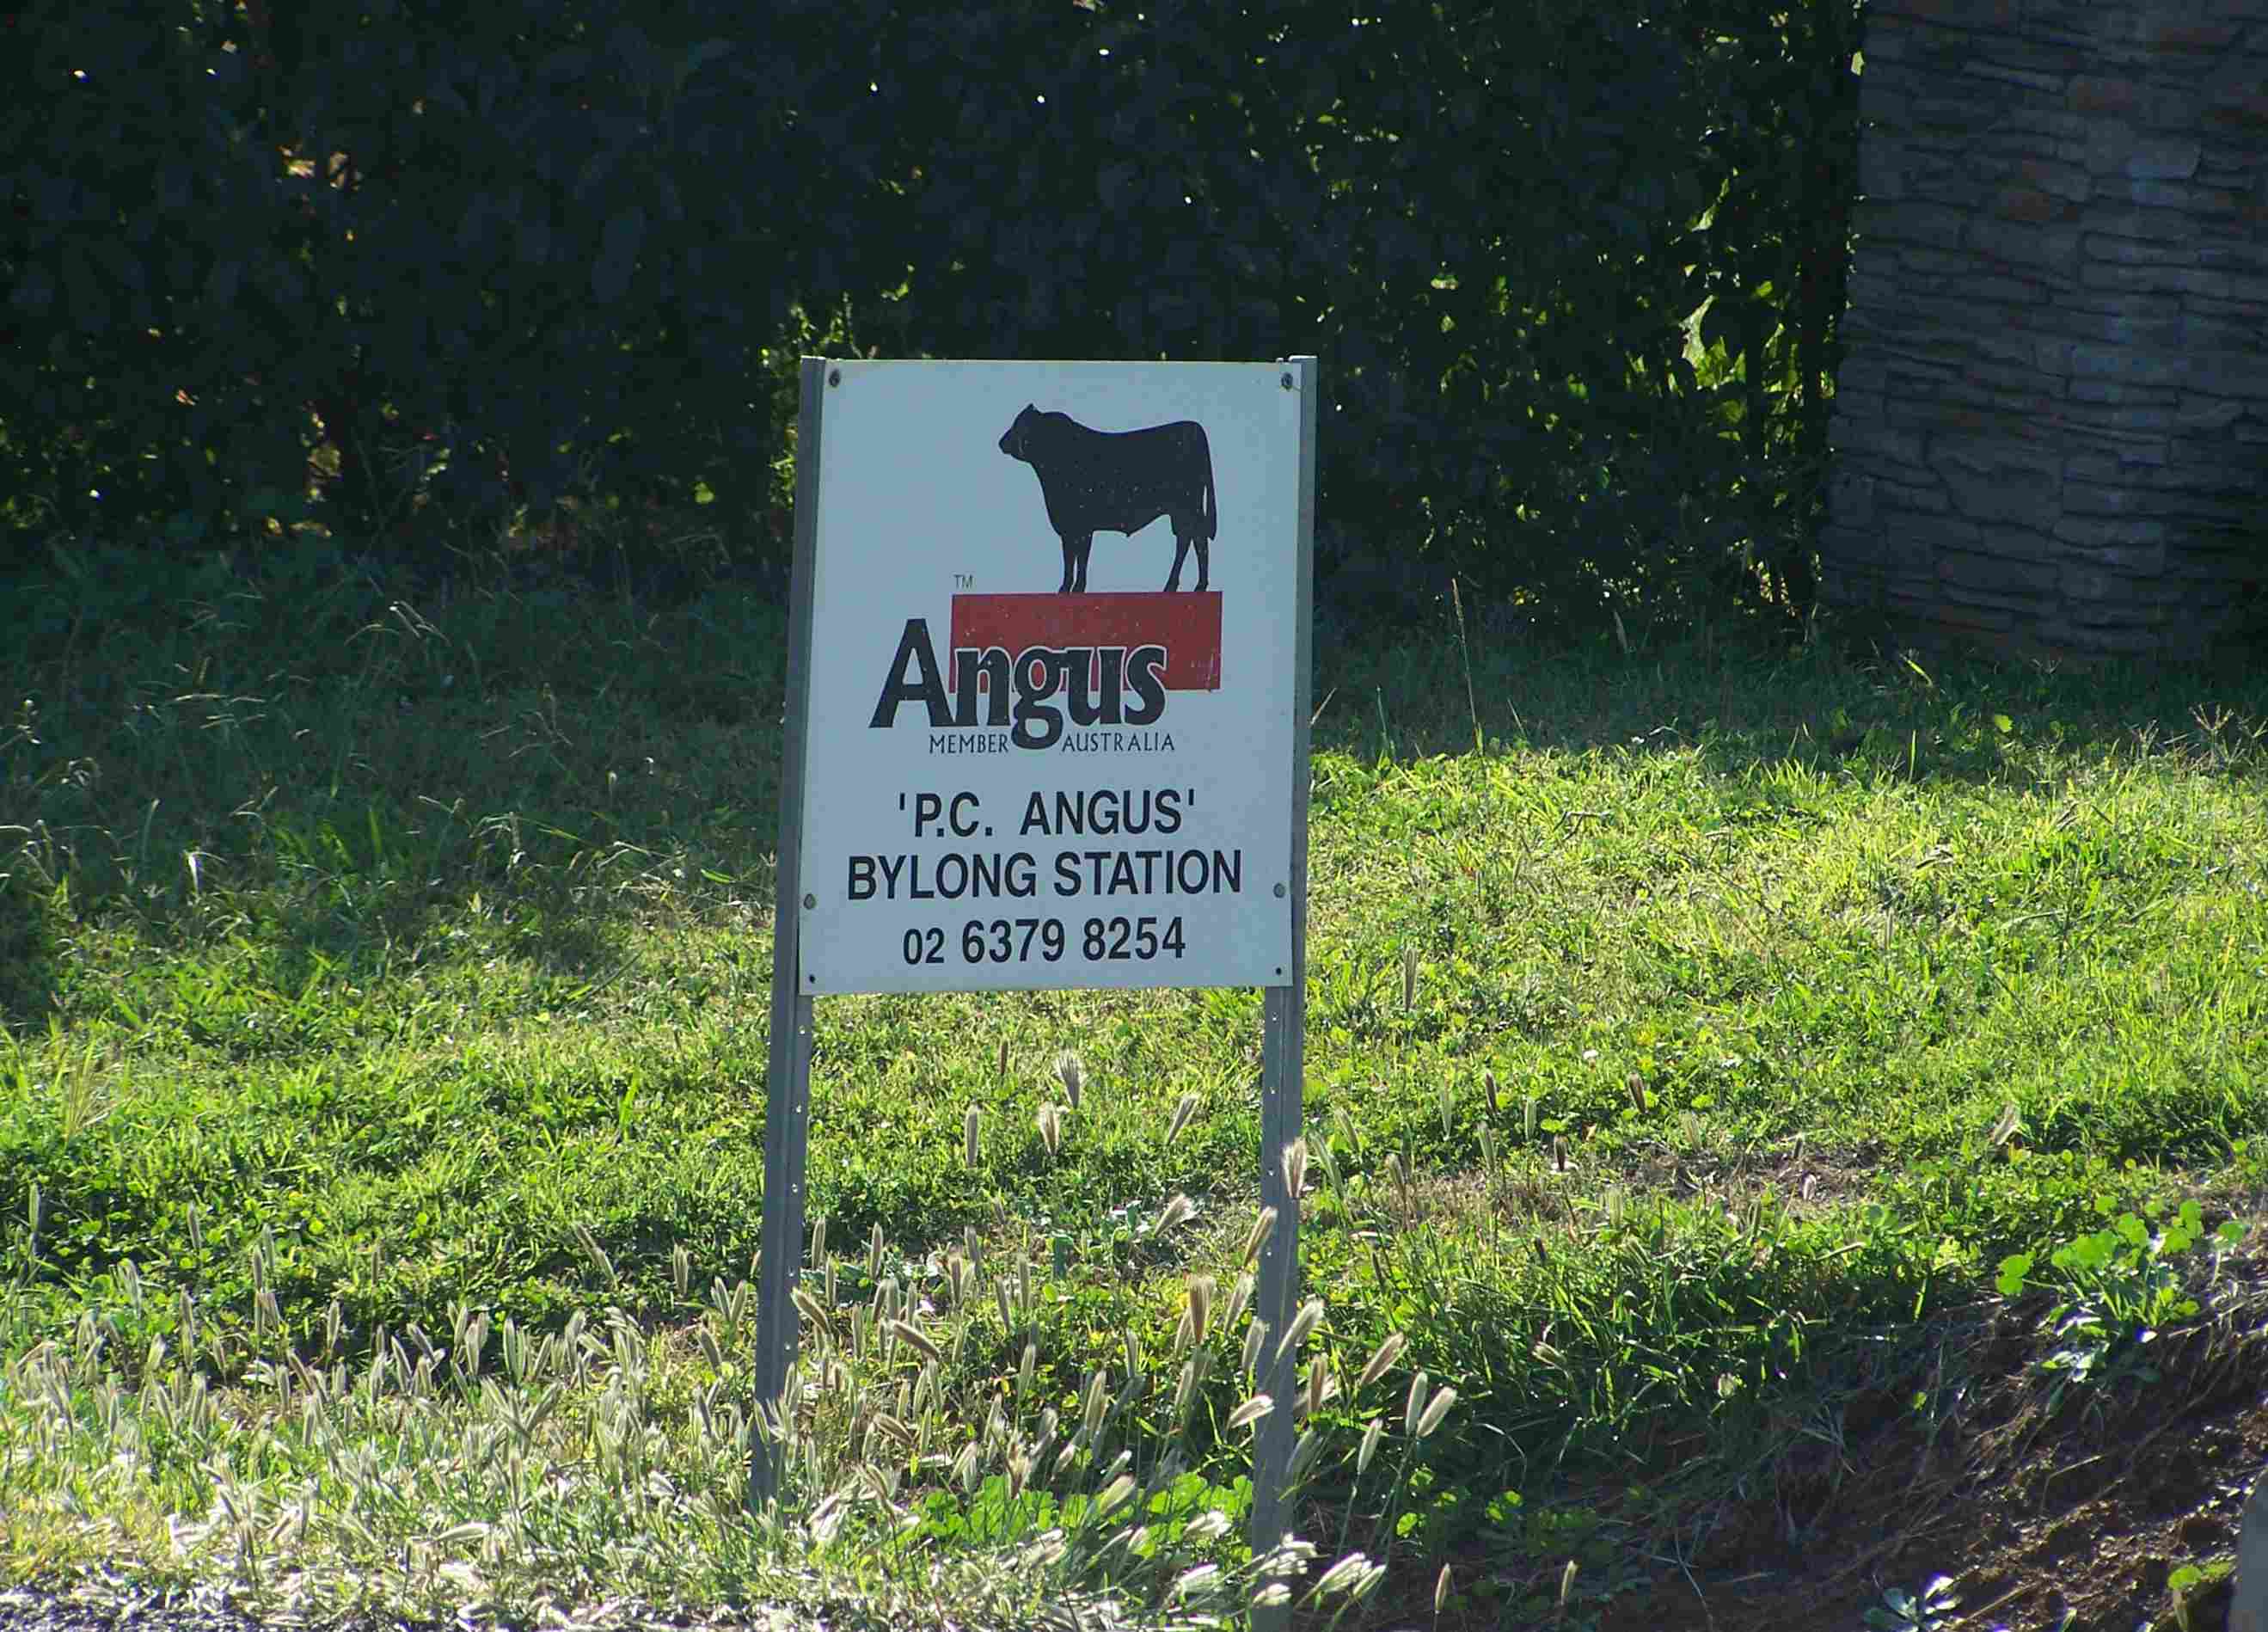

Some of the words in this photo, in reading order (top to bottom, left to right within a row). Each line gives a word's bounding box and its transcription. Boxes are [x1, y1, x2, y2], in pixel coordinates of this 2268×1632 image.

[953, 574, 974, 589] TM
[868, 618, 1167, 750] Angus
[929, 734, 1009, 754] MEMBER
[1062, 732, 1175, 752] AUSTRALIA
[898, 791, 993, 837] 'P.C.
[1020, 788, 1195, 836] ANGUS'
[847, 853, 1037, 900] BYLONG
[1053, 850, 1241, 896] STATION
[903, 928, 946, 964] 02
[961, 919, 1066, 963] 6379
[1082, 916, 1186, 960] 8254
